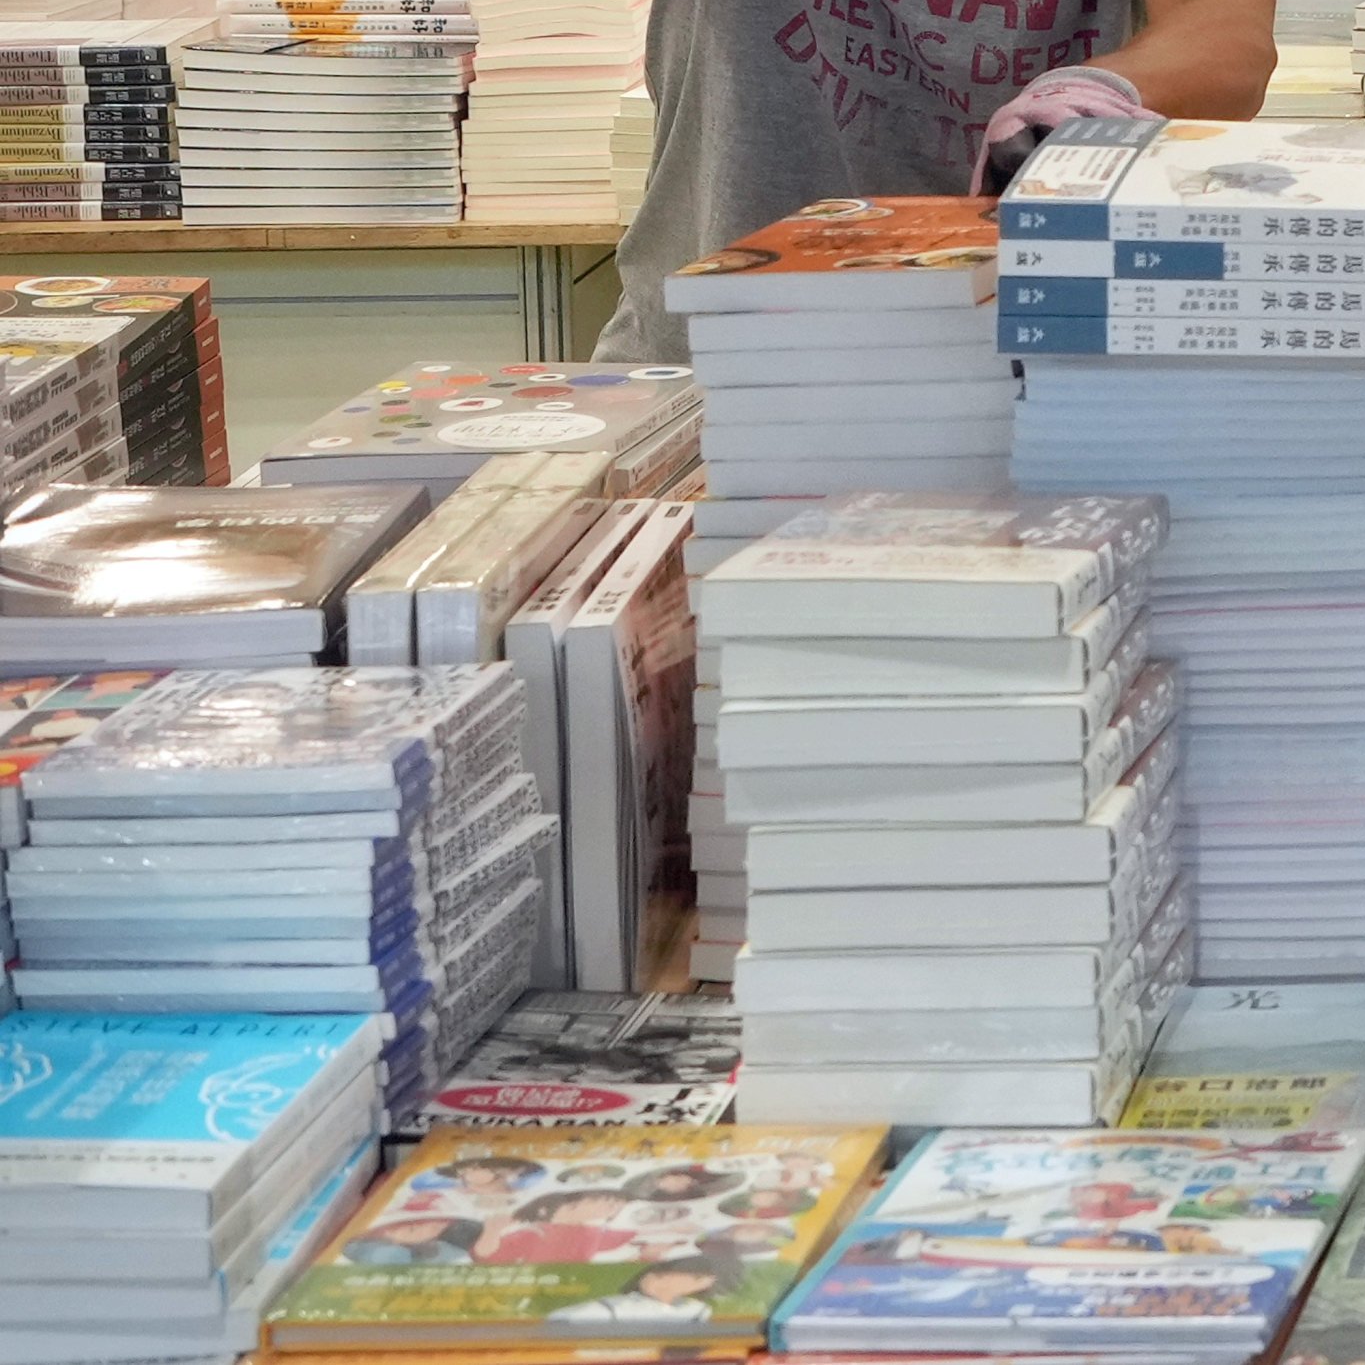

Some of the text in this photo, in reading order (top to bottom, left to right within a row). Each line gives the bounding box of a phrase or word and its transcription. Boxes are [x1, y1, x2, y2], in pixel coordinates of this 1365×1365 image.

[28, 51, 55, 64] The
[34, 70, 61, 82] The
[844, 35, 971, 115] EASTERN
[38, 88, 64, 101] The
[14, 166, 79, 180] Byzantium
[15, 186, 78, 199] The Bible
[14, 205, 76, 219] The Bible
